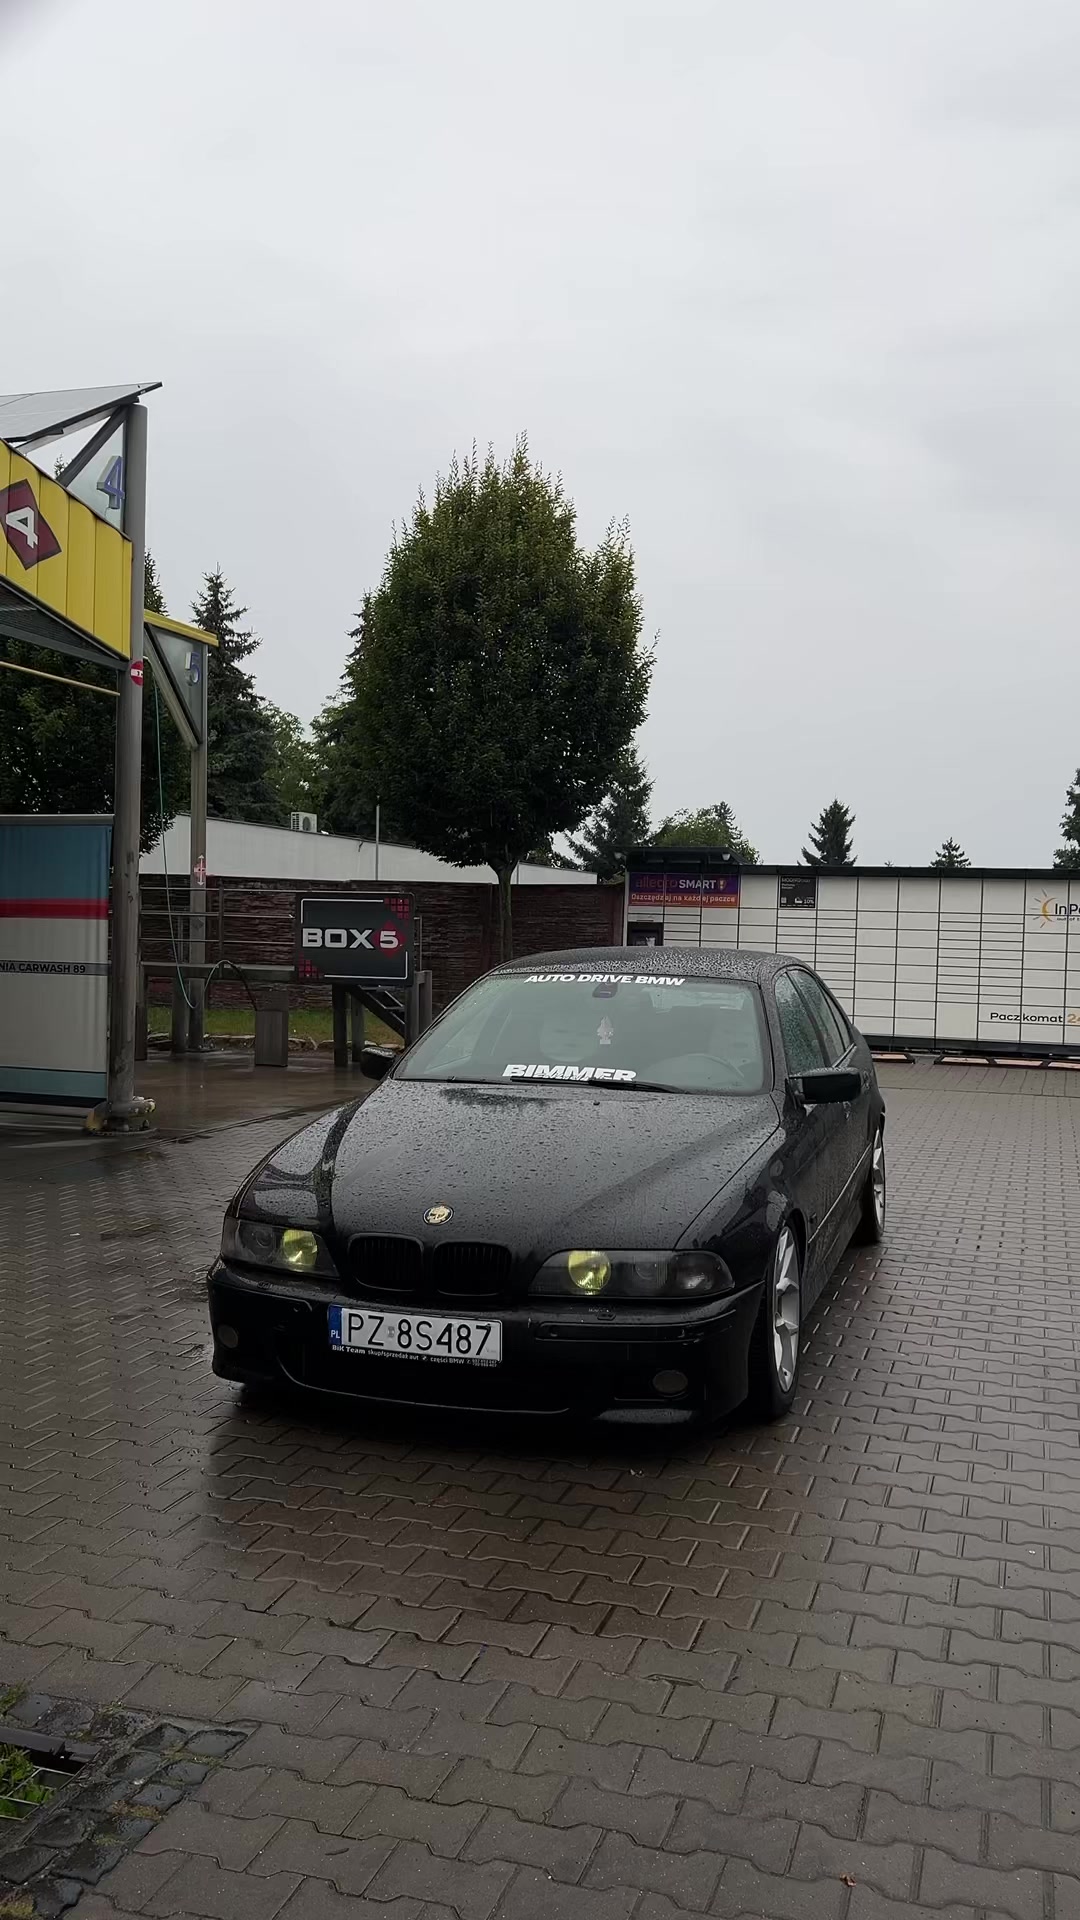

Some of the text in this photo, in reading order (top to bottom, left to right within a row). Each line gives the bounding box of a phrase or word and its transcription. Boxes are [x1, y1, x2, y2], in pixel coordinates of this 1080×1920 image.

[97, 456, 125, 509] 4
[5, 506, 38, 549] 4
[185, 651, 200, 686] 5
[1055, 903, 1080, 915] InP
[302, 928, 399, 949] BOX 5
[19, 963, 71, 973] CARWASH
[73, 965, 86, 974] 89
[524, 974, 685, 986] AUTO DRIVE BMW
[990, 1012, 1064, 1023] Paczkomat
[502, 1064, 637, 1081] BIMMER
[330, 1329, 341, 1339] PL
[348, 1312, 492, 1356] PZ 8S487
[345, 1346, 366, 1355] Team
